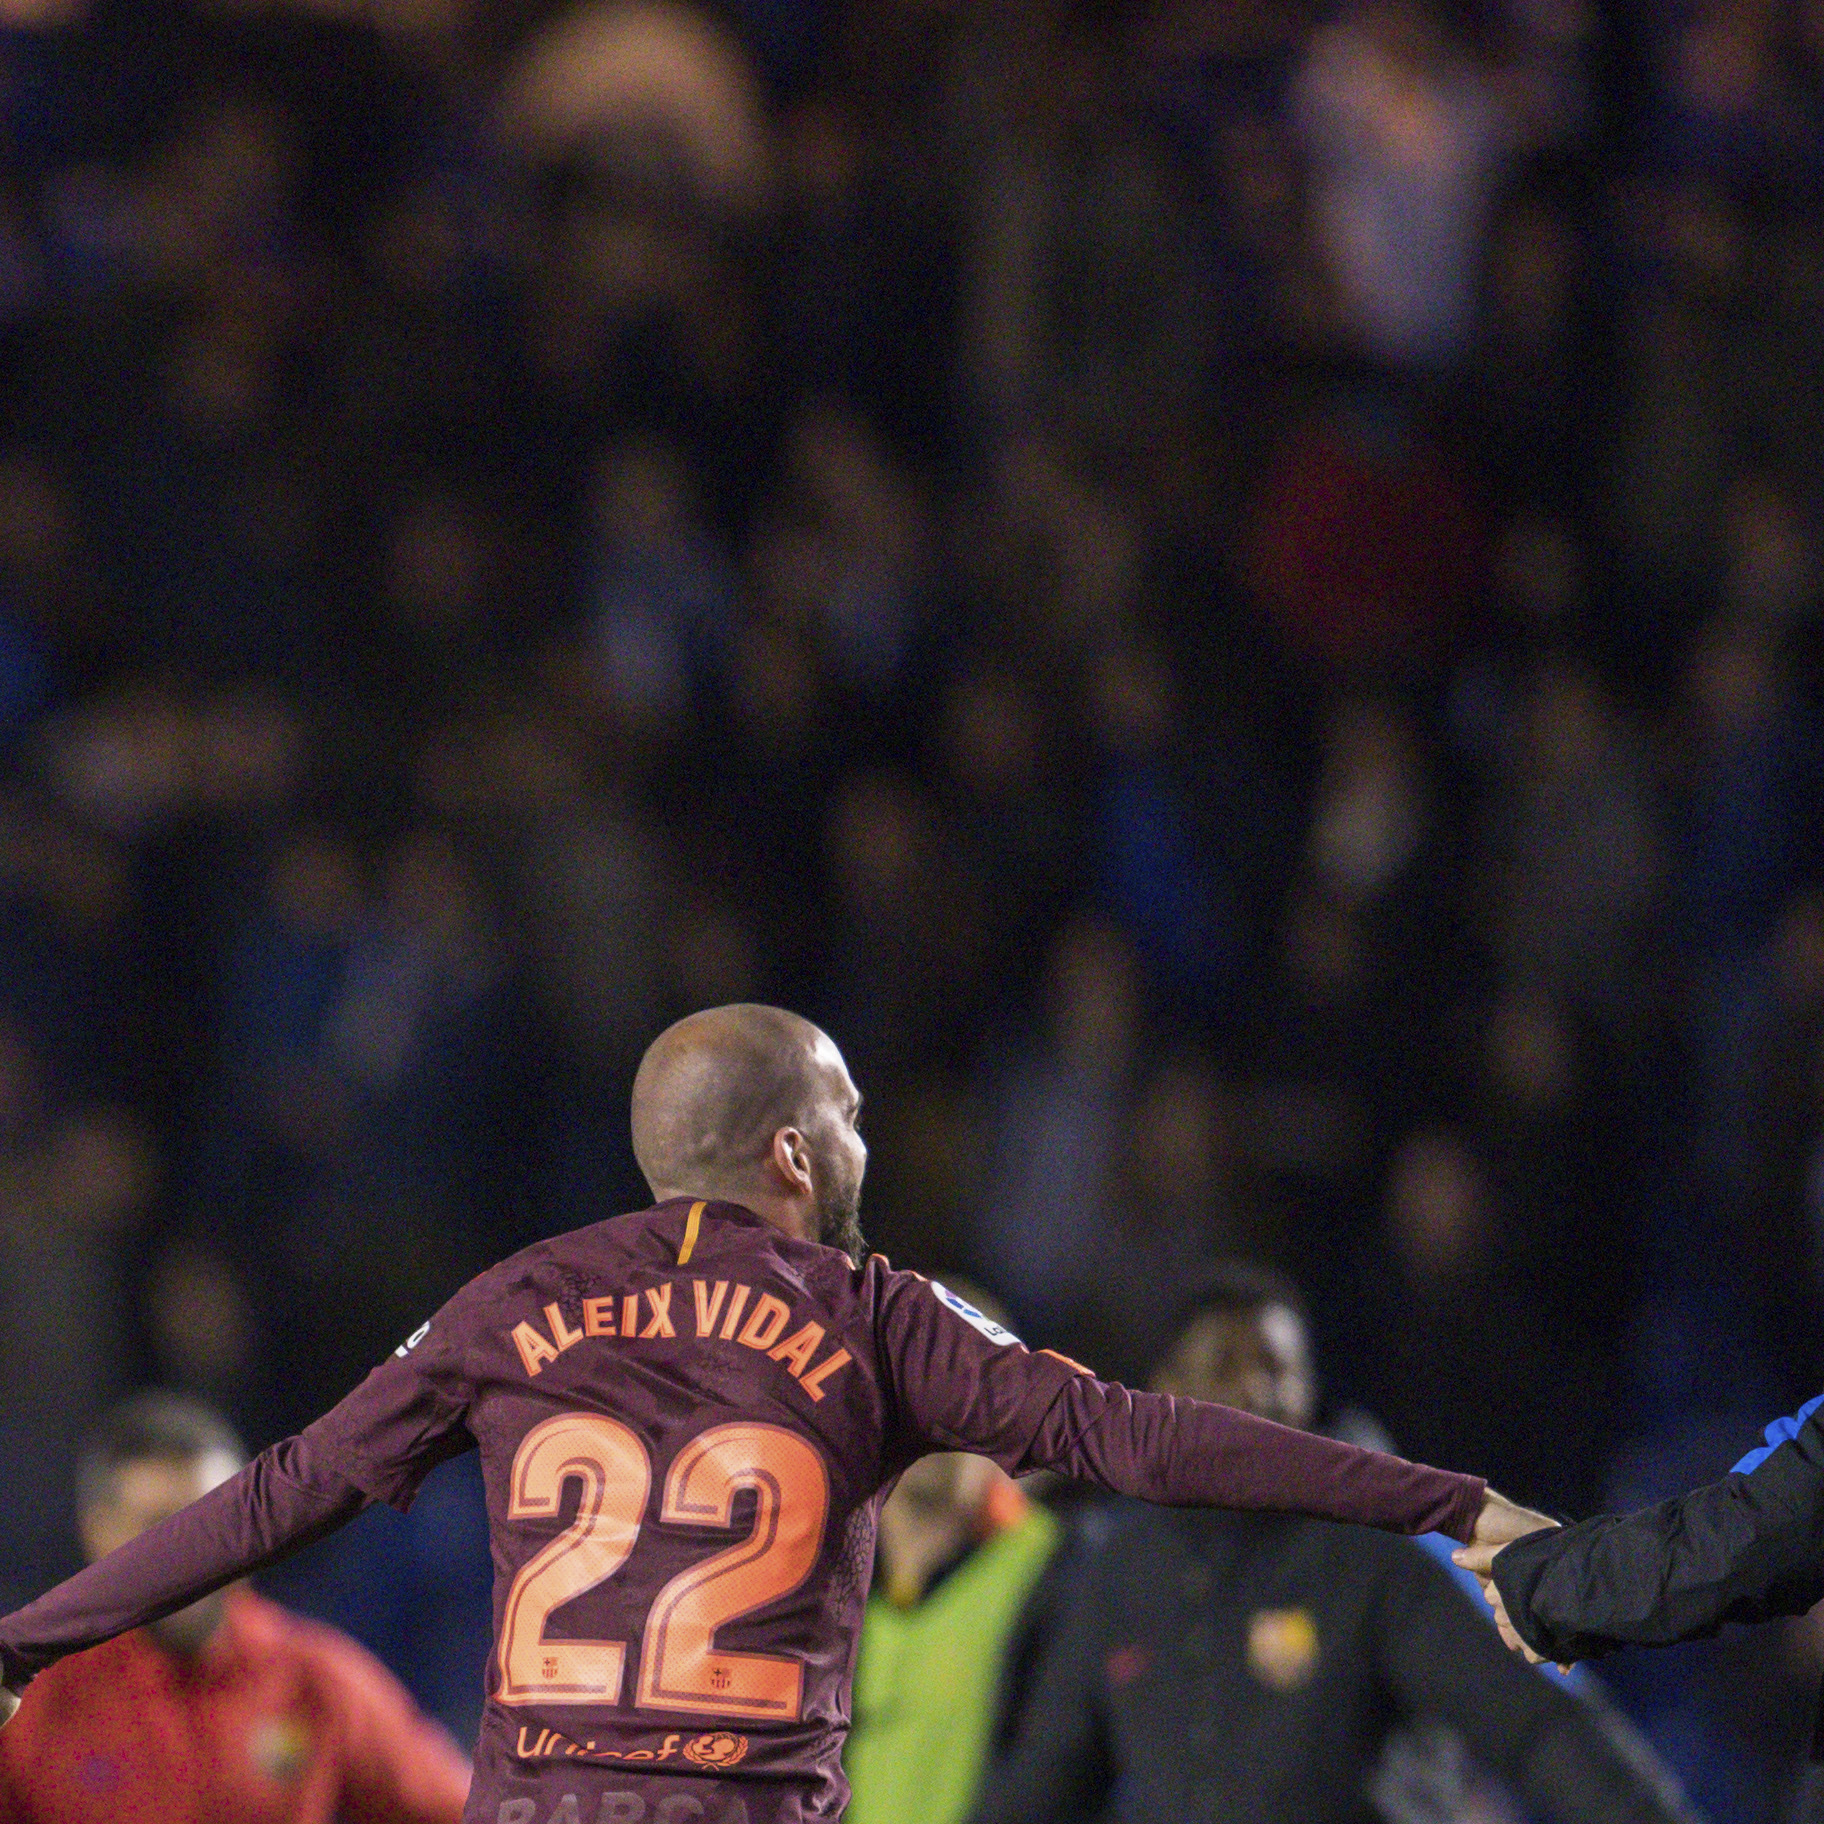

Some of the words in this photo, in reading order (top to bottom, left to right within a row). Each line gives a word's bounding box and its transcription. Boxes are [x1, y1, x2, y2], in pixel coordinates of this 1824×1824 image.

[511, 1282, 676, 1378] ALEIX
[693, 1280, 853, 1402] VIDAL
[494, 1412, 830, 1722] 22
[517, 1726, 681, 1761] unief
